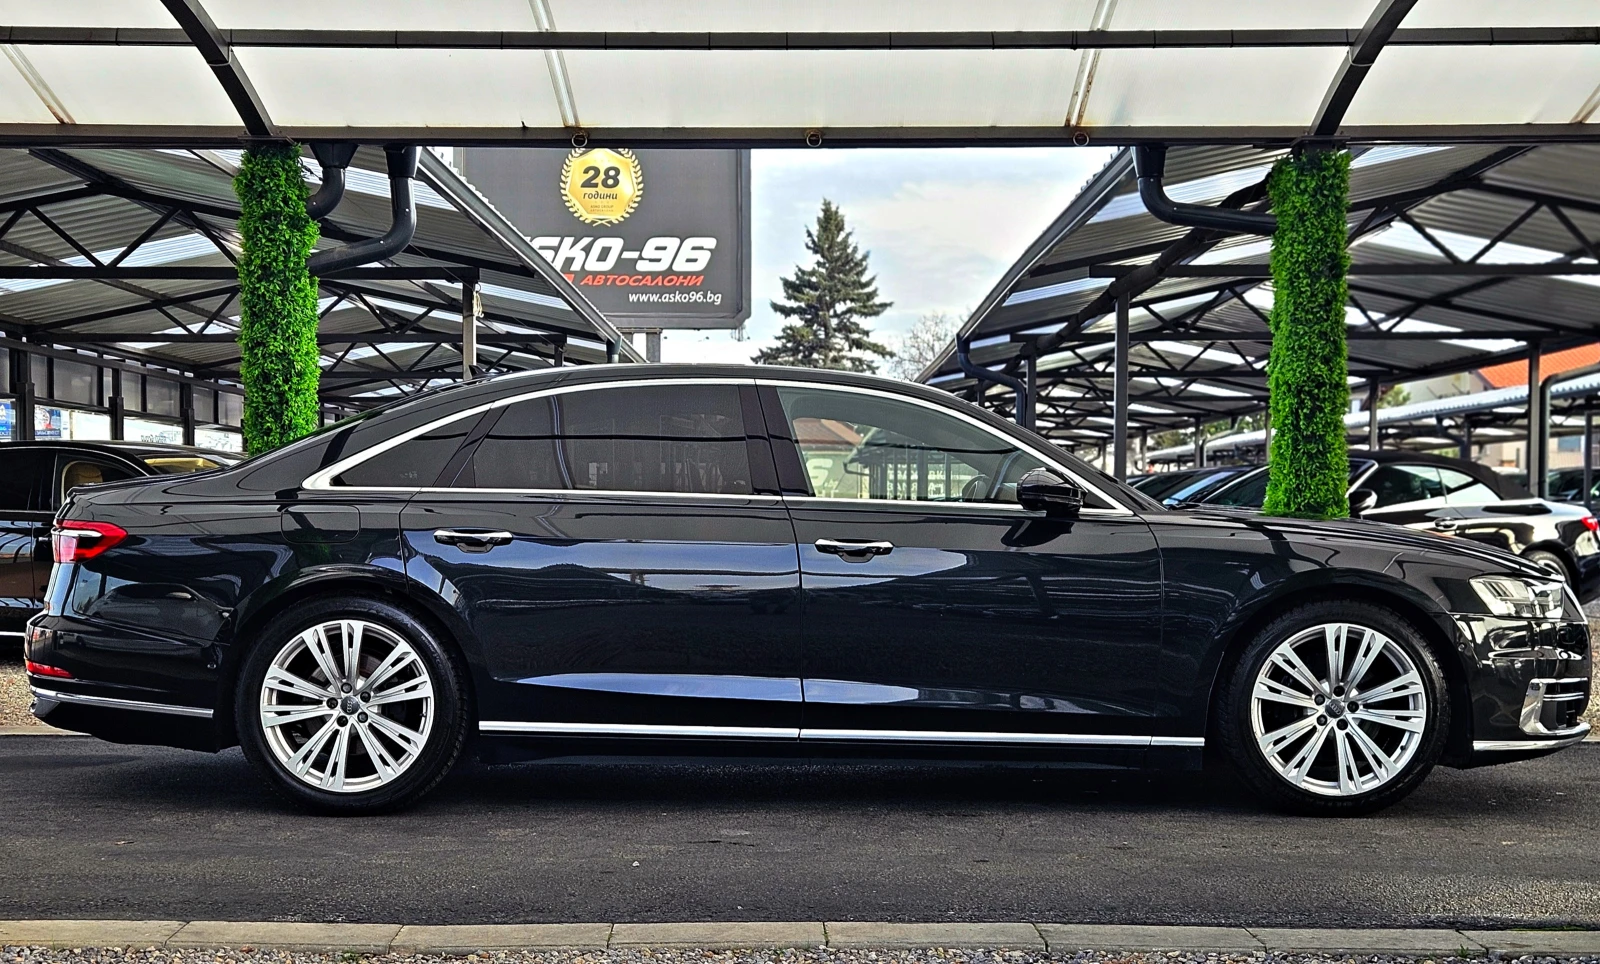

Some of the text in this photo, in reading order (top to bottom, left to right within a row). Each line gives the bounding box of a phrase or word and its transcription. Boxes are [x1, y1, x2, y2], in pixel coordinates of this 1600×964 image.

[580, 165, 621, 189] 28
[583, 190, 618, 200] години
[524, 236, 717, 272] SKO-96
[580, 274, 704, 286] АВТОСАЛОНИ
[628, 291, 722, 305] www.asko96.bg
